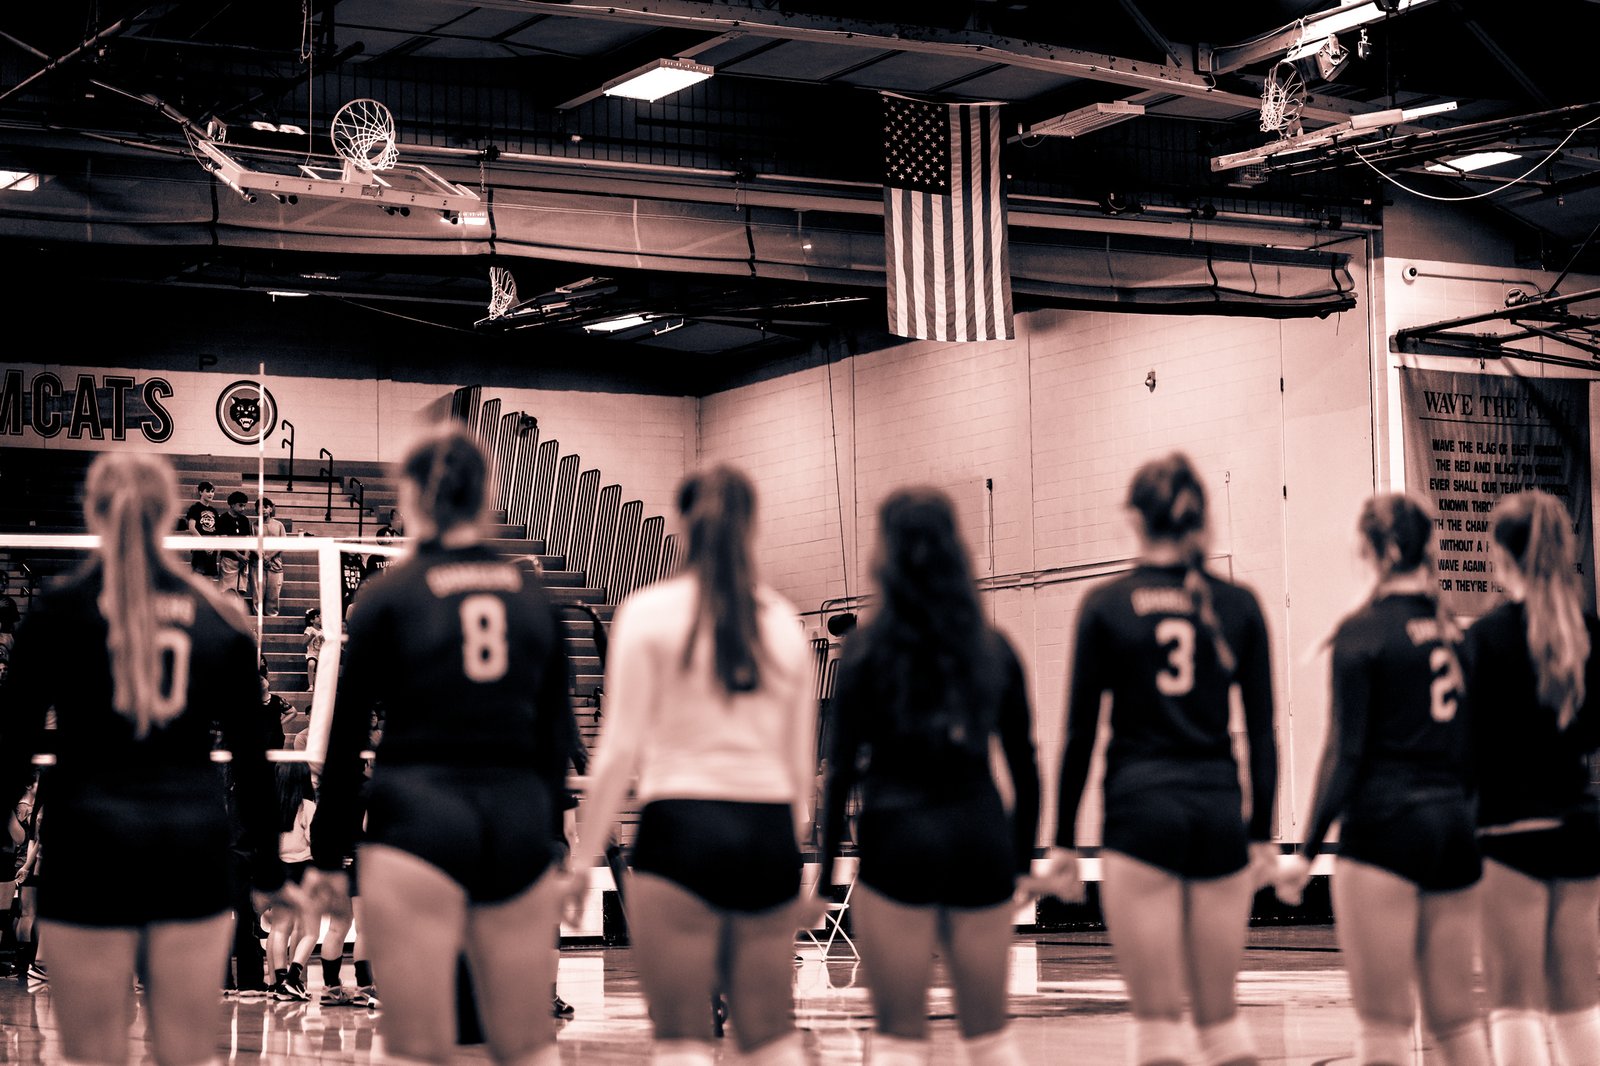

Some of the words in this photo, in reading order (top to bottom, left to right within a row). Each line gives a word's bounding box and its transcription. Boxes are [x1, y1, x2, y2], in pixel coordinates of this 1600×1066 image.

[1423, 390, 1473, 416] WAVE
[1479, 395, 1518, 418] THE
[1523, 396, 1571, 421] FLG
[1432, 438, 1455, 452] WAVE
[1458, 440, 1473, 453] THE
[1476, 441, 1496, 455] FLAG
[1499, 443, 1508, 455] OF
[1512, 443, 1530, 456] EAST
[1435, 458, 1451, 471] THE
[1454, 460, 1470, 472] RED
[1473, 461, 1491, 473] AND
[1494, 462, 1518, 475] BLACK
[1429, 477, 1450, 491] EVER
[1453, 479, 1478, 492] SHALL
[1481, 480, 1497, 493] OUR
[1500, 482, 1522, 494] TEAM
[1438, 498, 1469, 512] KNOWN
[1446, 519, 1462, 531] THE
[1439, 538, 1474, 552] WITHOUT
[1476, 541, 1483, 552] A
[1437, 558, 1459, 572] WAVE
[1462, 560, 1486, 573] AGAIN
[1438, 578, 1453, 591] FOR
[1455, 580, 1488, 593] THEY'RE
[460, 594, 509, 683] 8
[1155, 617, 1196, 696] 3
[1429, 647, 1459, 723] 2
